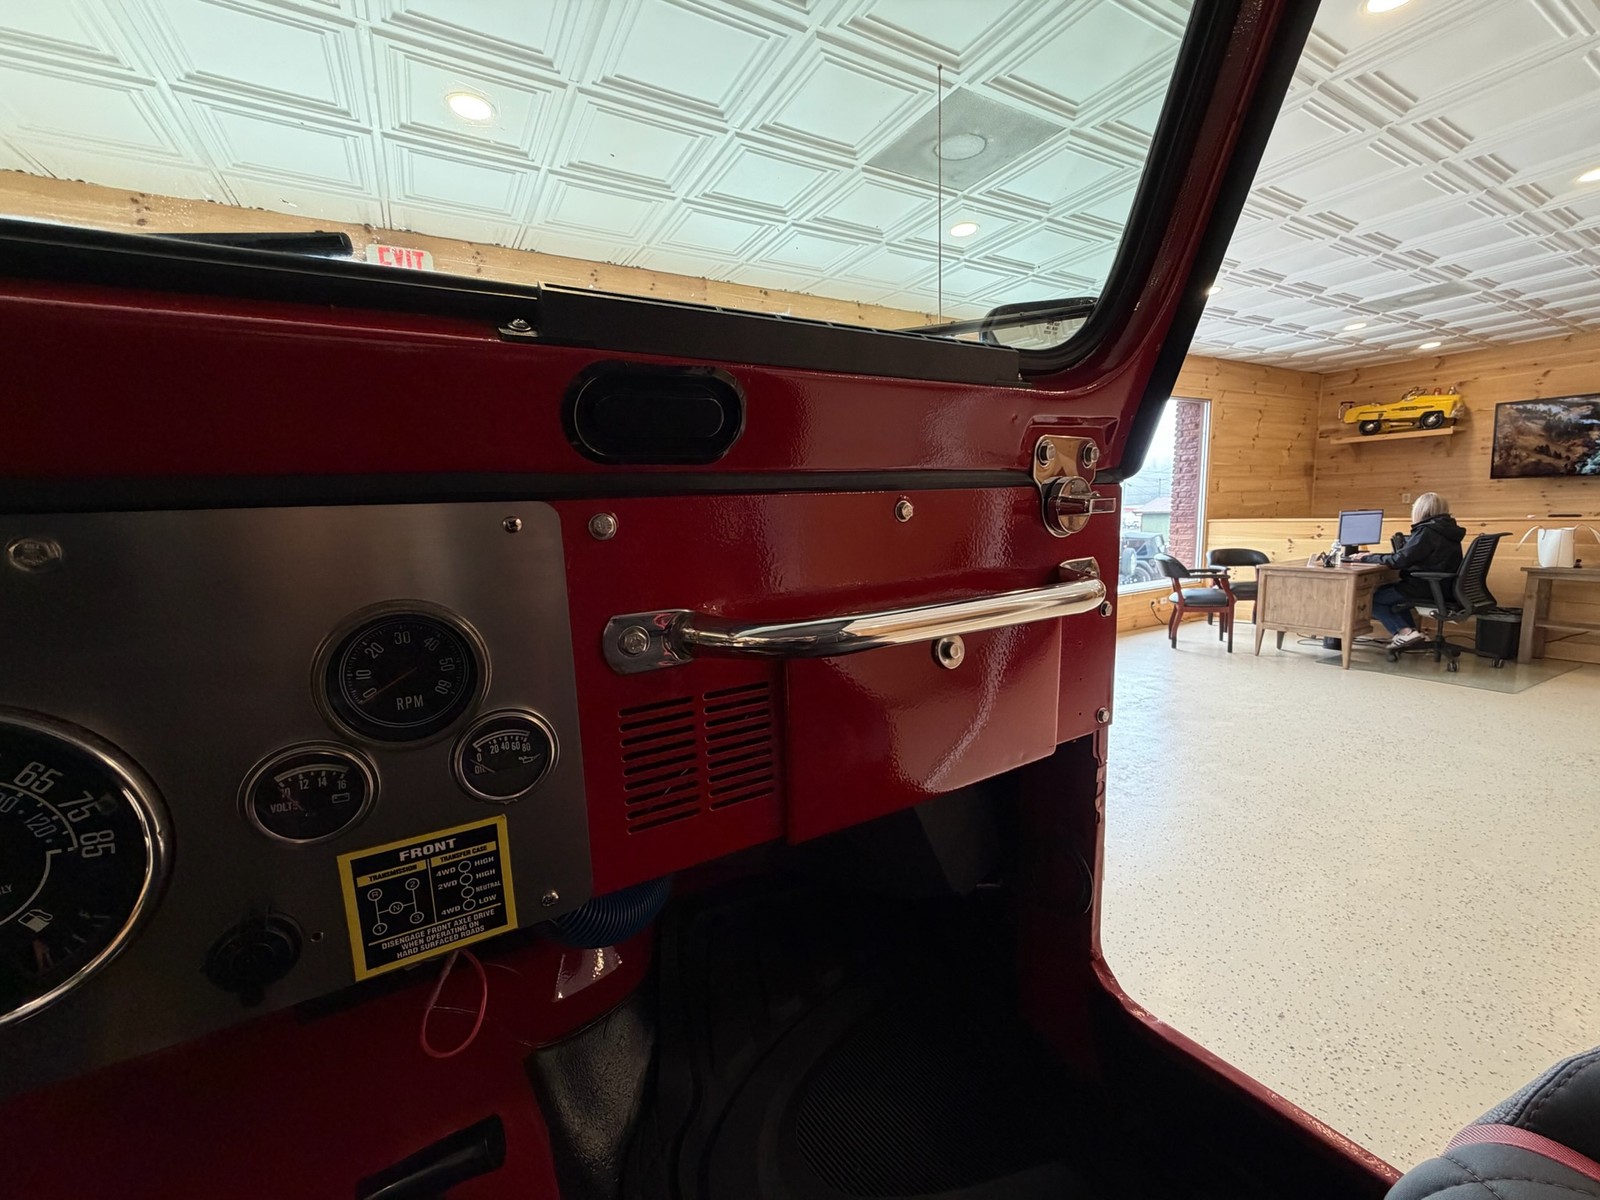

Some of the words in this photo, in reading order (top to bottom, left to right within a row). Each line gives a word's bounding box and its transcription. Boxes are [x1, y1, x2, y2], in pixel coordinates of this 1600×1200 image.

[377, 246, 425, 270] EXIT
[394, 631, 411, 644] 30
[423, 636, 440, 652] 40
[364, 642, 384, 659] 20
[439, 657, 456, 672] 50
[355, 669, 372, 680] 10
[362, 687, 377, 699] 0
[434, 679, 452, 695] 60
[396, 694, 424, 711] RPM
[490, 744, 500, 754] 20
[500, 741, 510, 750] 40
[511, 741, 520, 751] 60
[522, 742, 531, 752] 80
[476, 752, 482, 762] 0
[13, 761, 64, 794] 65
[299, 778, 310, 790] 12
[317, 776, 328, 788] 14
[337, 780, 347, 790] 16
[57, 790, 102, 822] 75
[270, 801, 299, 814] VOLTS
[24, 812, 58, 838] 120
[80, 829, 116, 858] 85
[399, 838, 457, 862] FRONT
[440, 849, 472, 862] TRANSFER
[472, 845, 488, 854] CASE
[368, 864, 418, 882] TRANSMISSION
[436, 866, 456, 877] 4WD
[474, 856, 494, 867] HIGH
[408, 880, 417, 888] 2
[437, 880, 458, 890] 2WD
[476, 868, 496, 879] HIGH
[475, 880, 502, 892] NEUTRAL
[440, 905, 460, 916] 4WD
[478, 894, 497, 904] LOW
[382, 928, 426, 950] DISENGAGE
[427, 922, 452, 934] FRONT
[454, 916, 472, 926] AXLE
[473, 908, 496, 920] DRIVE
[401, 938, 424, 950] WHEN
[426, 924, 468, 942] OPERATING
[468, 920, 480, 929] ON
[396, 947, 418, 960] HARD
[420, 934, 459, 952] SURFACED
[460, 925, 485, 938] ROADS
